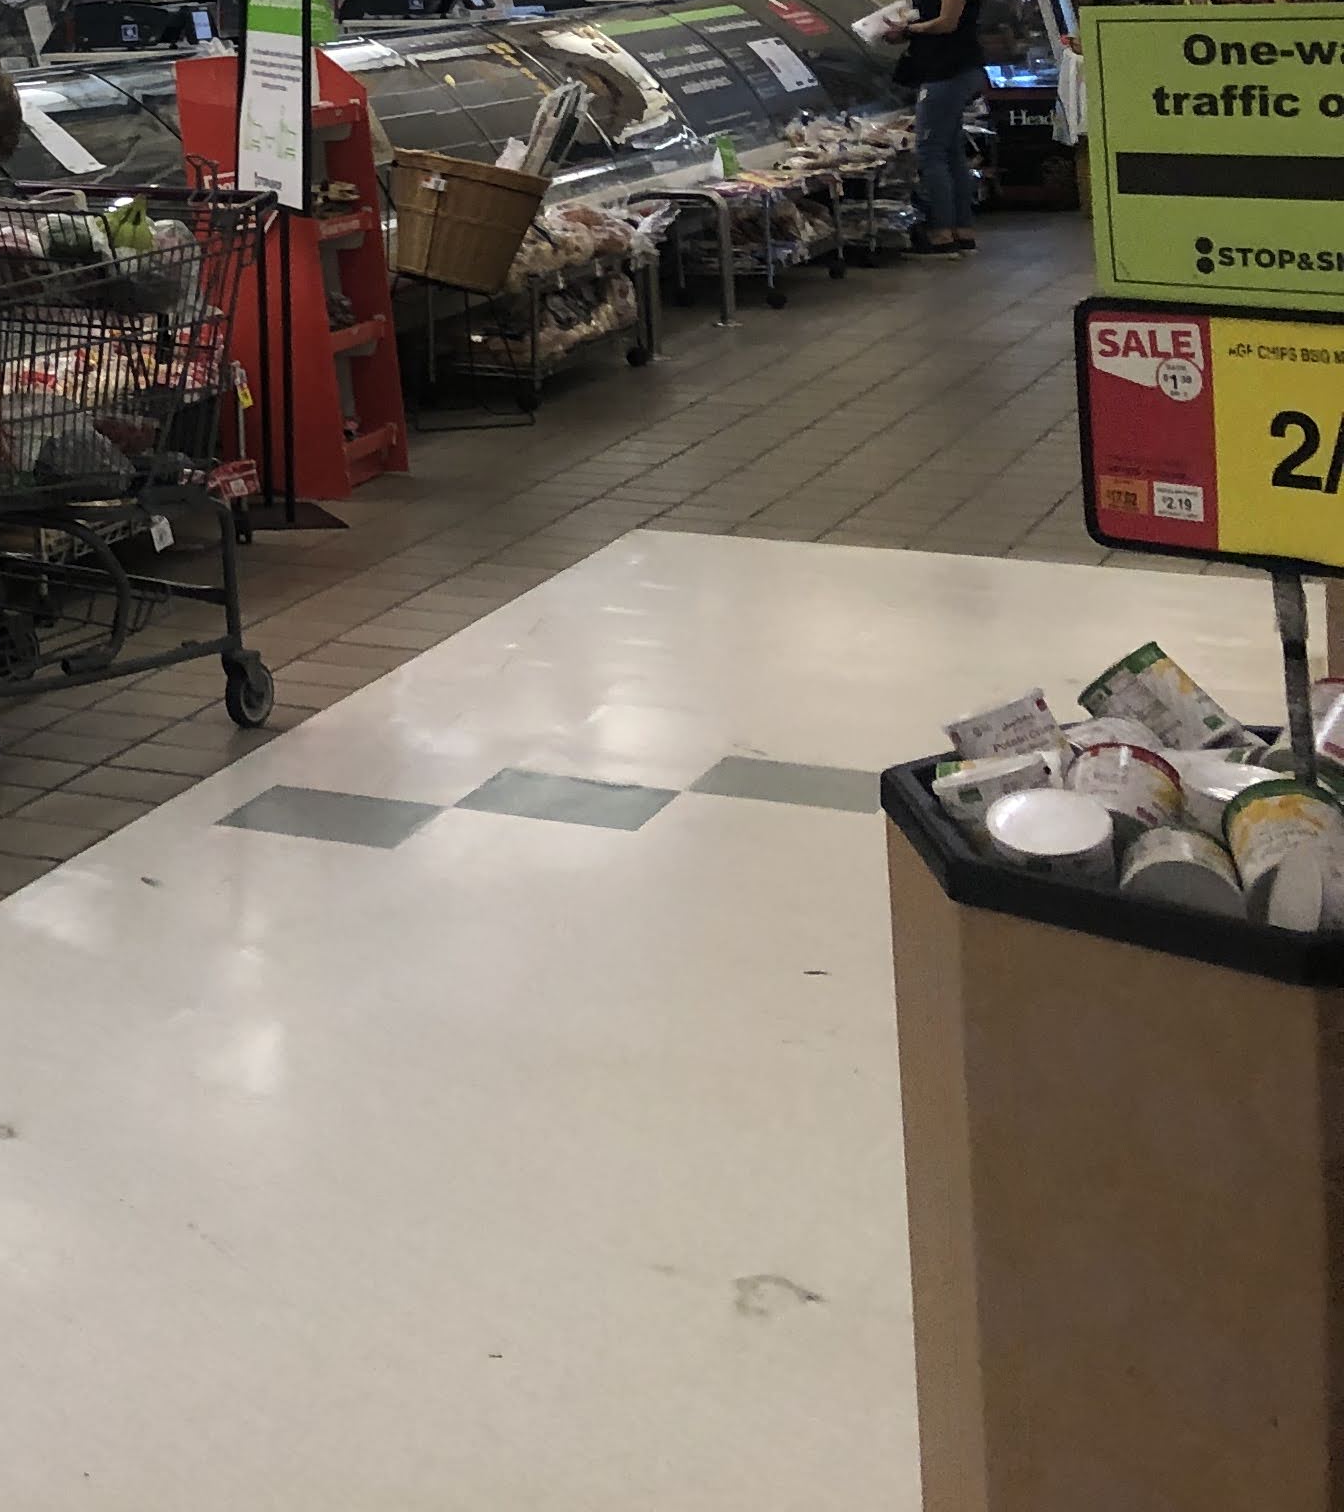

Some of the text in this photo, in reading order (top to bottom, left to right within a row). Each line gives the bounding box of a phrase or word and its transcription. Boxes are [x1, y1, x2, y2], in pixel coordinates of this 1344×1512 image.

[1183, 32, 1344, 67] One-w
[1152, 83, 1301, 118] traffic
[1097, 328, 1196, 360] SALE
